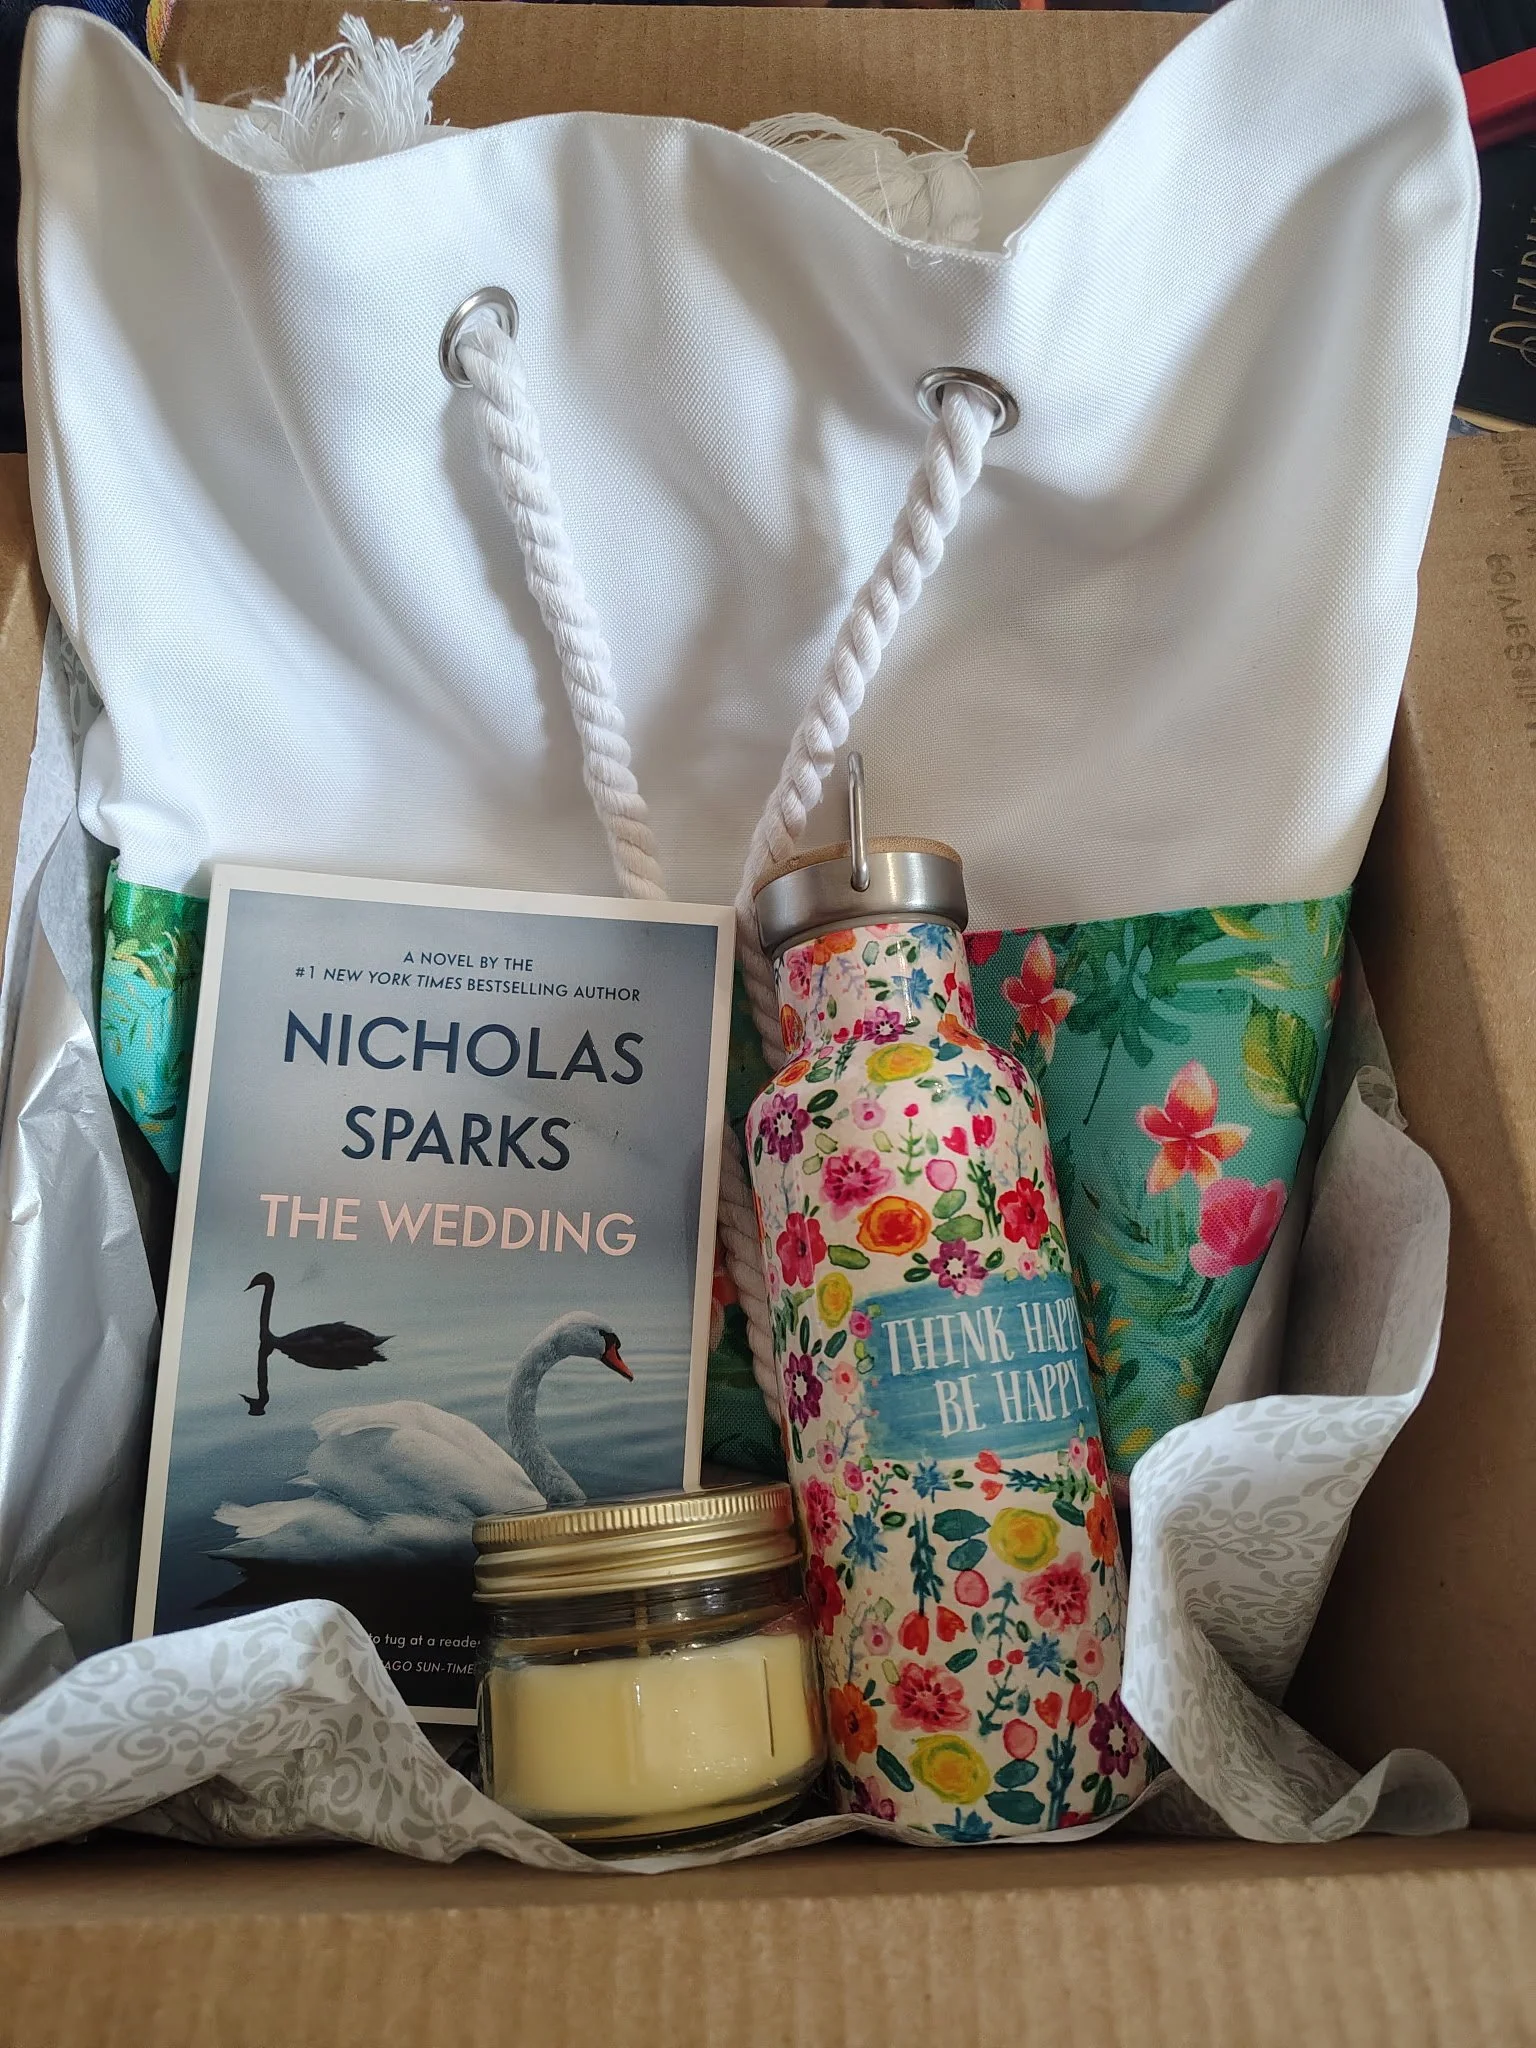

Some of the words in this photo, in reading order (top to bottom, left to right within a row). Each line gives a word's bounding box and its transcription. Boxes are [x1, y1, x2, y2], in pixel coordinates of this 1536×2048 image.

[295, 965, 315, 980] #1
[323, 968, 363, 984] NEW
[369, 970, 411, 987] YORK
[417, 974, 462, 991] TIMES
[467, 978, 568, 998] BESTSELLING
[574, 985, 641, 1002] AUTHOR
[403, 951, 415, 965] A
[420, 952, 474, 968] NOVEL
[480, 956, 499, 970] BY
[504, 957, 534, 972] THE
[284, 1008, 644, 1085] NICHOLAS
[341, 1105, 572, 1171] SPARKS
[260, 1193, 361, 1242] THE
[378, 1200, 637, 1257] WEDDING
[881, 1305, 1015, 1377] THINK
[933, 1373, 986, 1439] BE
[383, 1660, 412, 1672] AGO
[416, 1661, 475, 1675] SUN-TIME
[385, 1633, 406, 1649] tug
[410, 1634, 424, 1646] at
[427, 1637, 435, 1647] a
